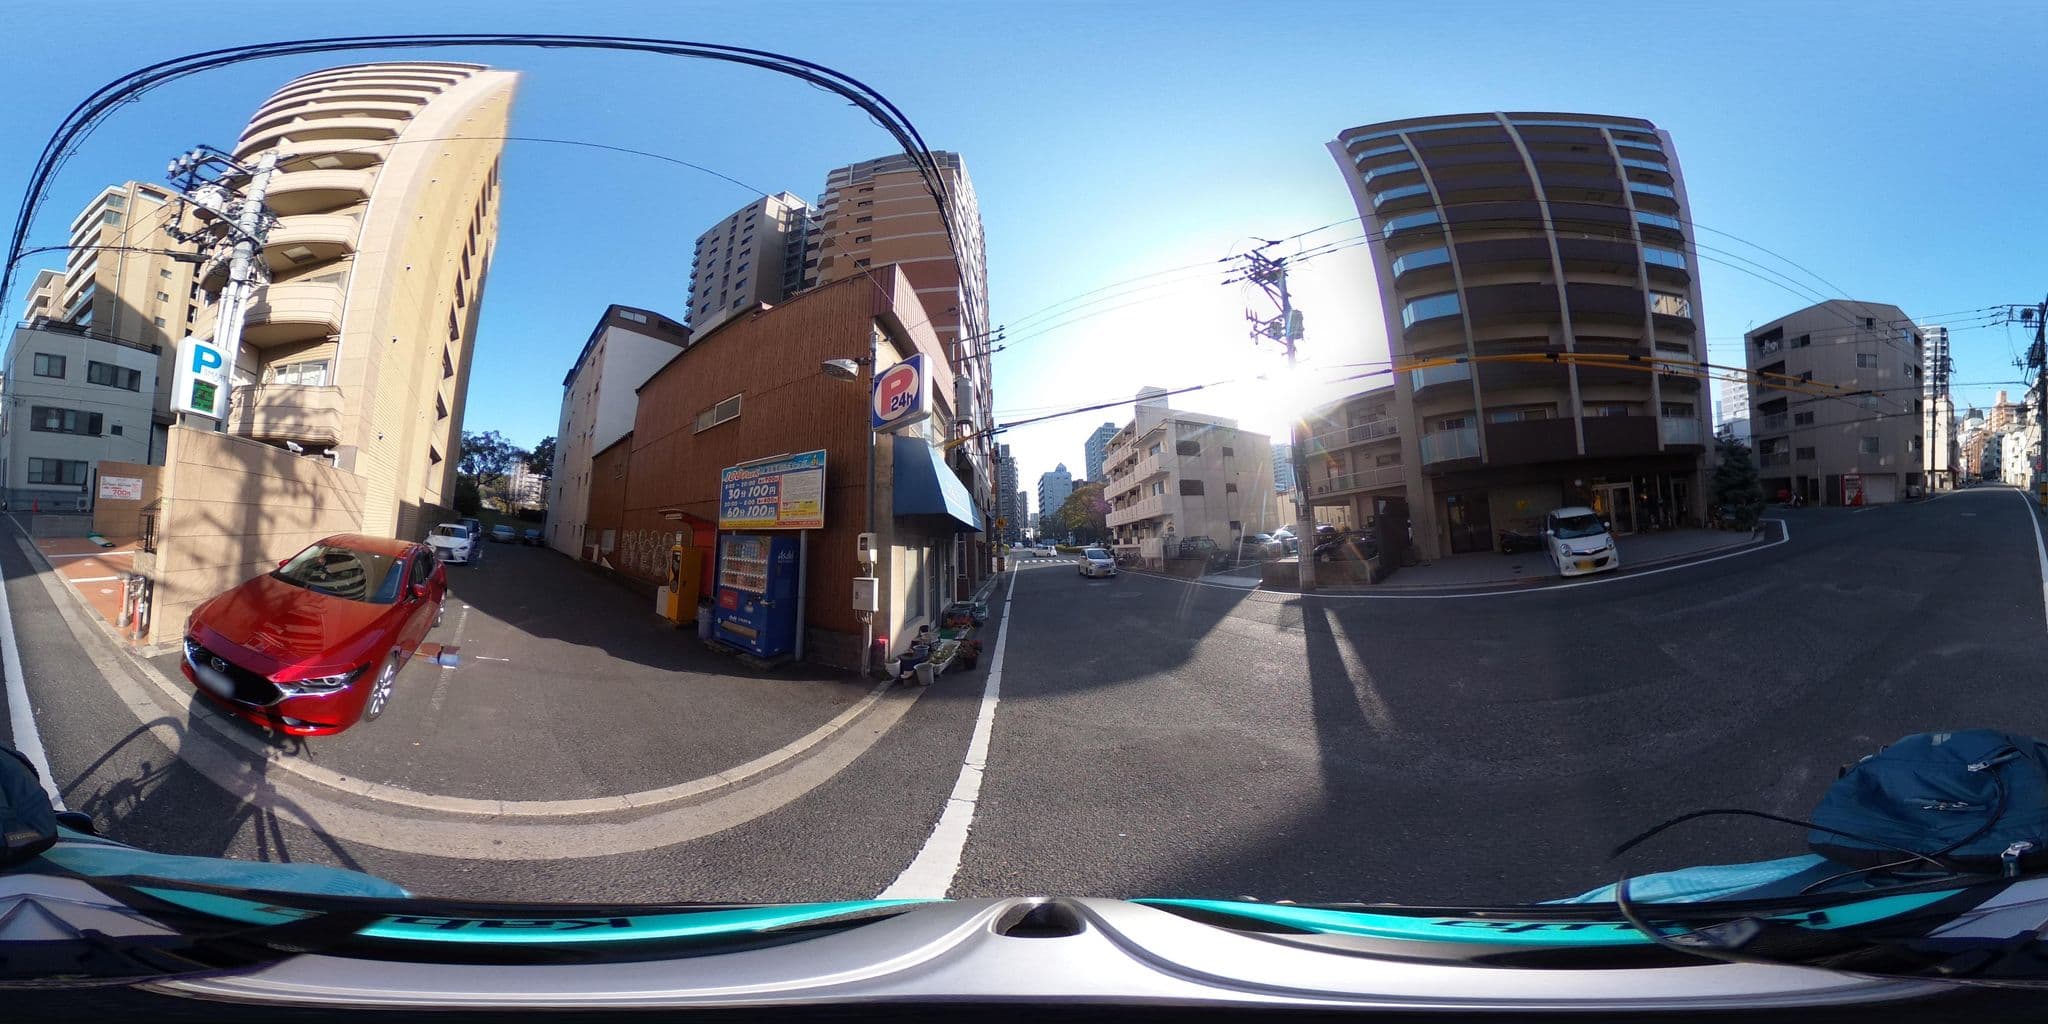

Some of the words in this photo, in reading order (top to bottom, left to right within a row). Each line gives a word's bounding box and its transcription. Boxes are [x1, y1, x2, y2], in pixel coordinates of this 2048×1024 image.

[192, 344, 222, 373] P
[880, 368, 914, 417] P
[891, 391, 913, 412] 24h
[748, 485, 776, 498] 100円
[747, 505, 775, 517] 100円
[395, 917, 632, 930] Kab
